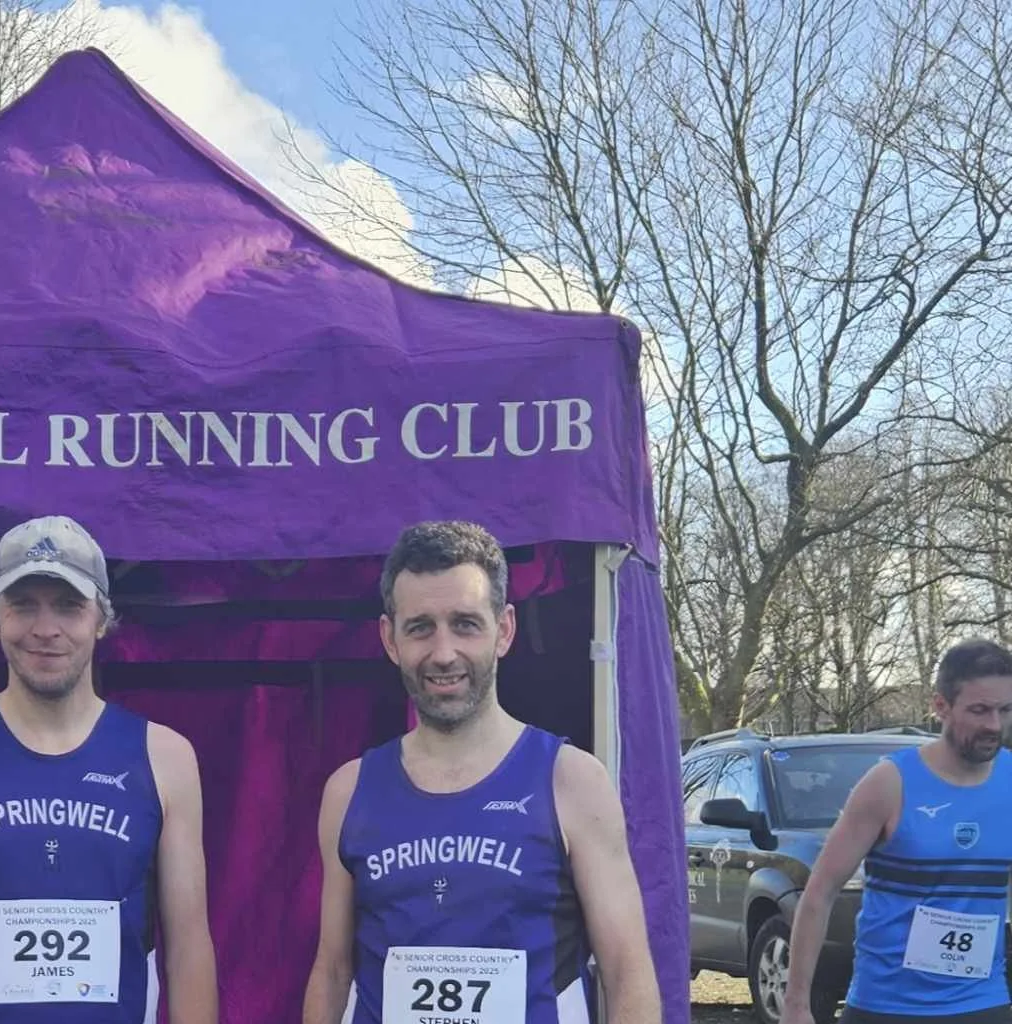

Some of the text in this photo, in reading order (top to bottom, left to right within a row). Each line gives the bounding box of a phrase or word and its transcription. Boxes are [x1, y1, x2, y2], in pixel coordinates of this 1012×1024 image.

[44, 407, 380, 468] RUNNING
[401, 398, 592, 459] CLUB
[367, 835, 523, 880] SPRINGWELL
[3, 907, 35, 915] SENIOR
[5, 918, 76, 926] CHAMPIONSHIPS
[14, 929, 90, 962] 292
[939, 930, 973, 952] 48
[436, 954, 465, 962] CROSS
[469, 955, 513, 963] COUNTRY
[940, 953, 965, 961] COLIN
[31, 966, 75, 977] JAMES
[411, 978, 491, 1013] 287
